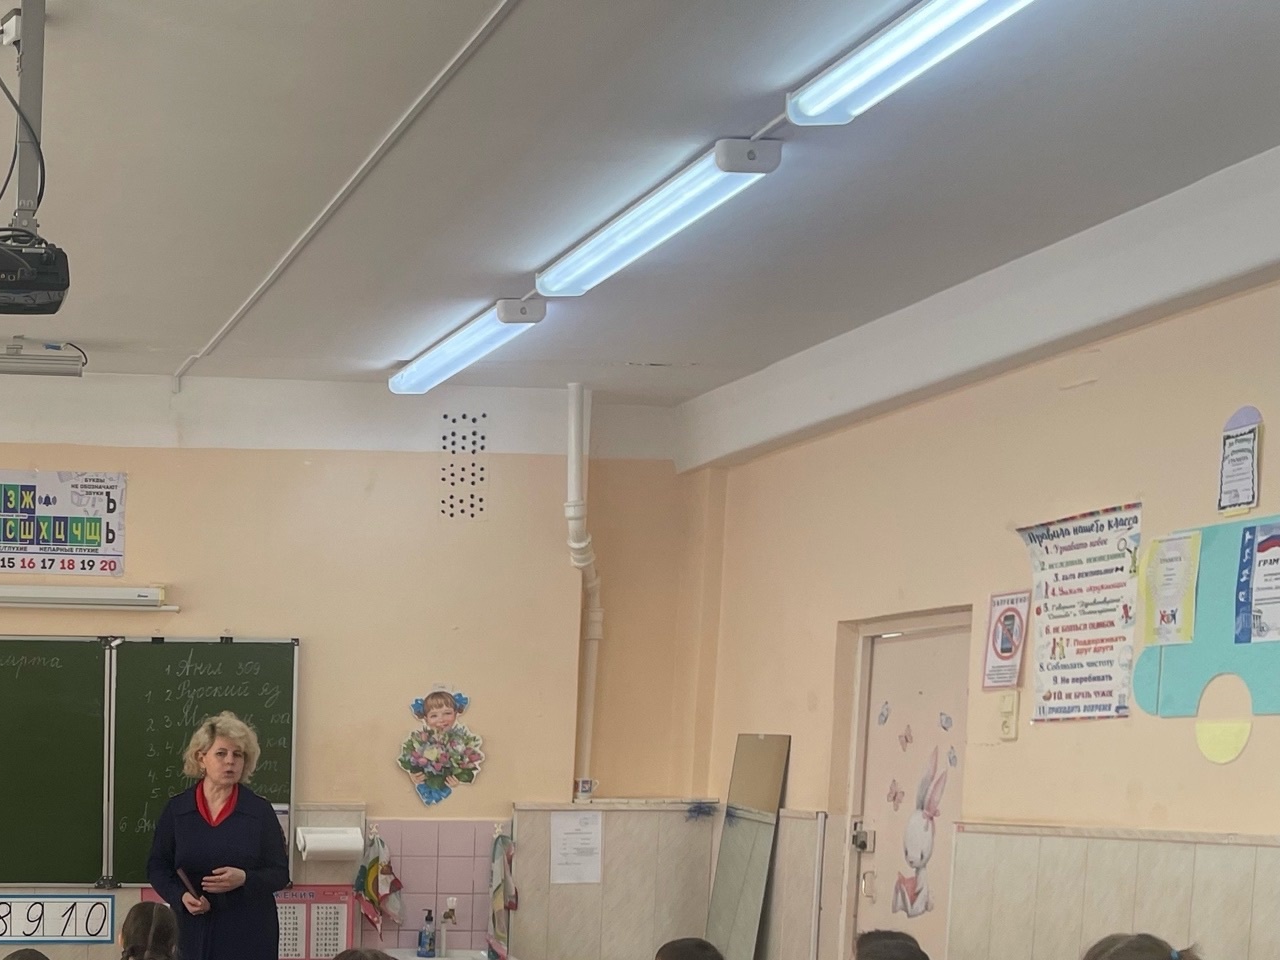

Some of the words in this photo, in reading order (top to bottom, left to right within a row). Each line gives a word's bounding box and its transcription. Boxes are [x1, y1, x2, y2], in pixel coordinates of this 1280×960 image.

[7, 490, 15, 508] З
[21, 491, 35, 509] Ж
[6, 520, 15, 539] С
[21, 520, 34, 539] Ш
[39, 520, 49, 539] Х
[56, 521, 65, 542] Ц
[72, 522, 81, 540] Ч
[86, 522, 101, 542] Щ
[0, 556, 15, 568] 15
[21, 557, 35, 569] 16
[41, 558, 55, 569] 17
[60, 558, 75, 570] 18
[80, 559, 95, 571] 19
[100, 559, 116, 571] 20
[1258, 558, 1280, 567] ГРАМ
[22, 902, 44, 937] 9
